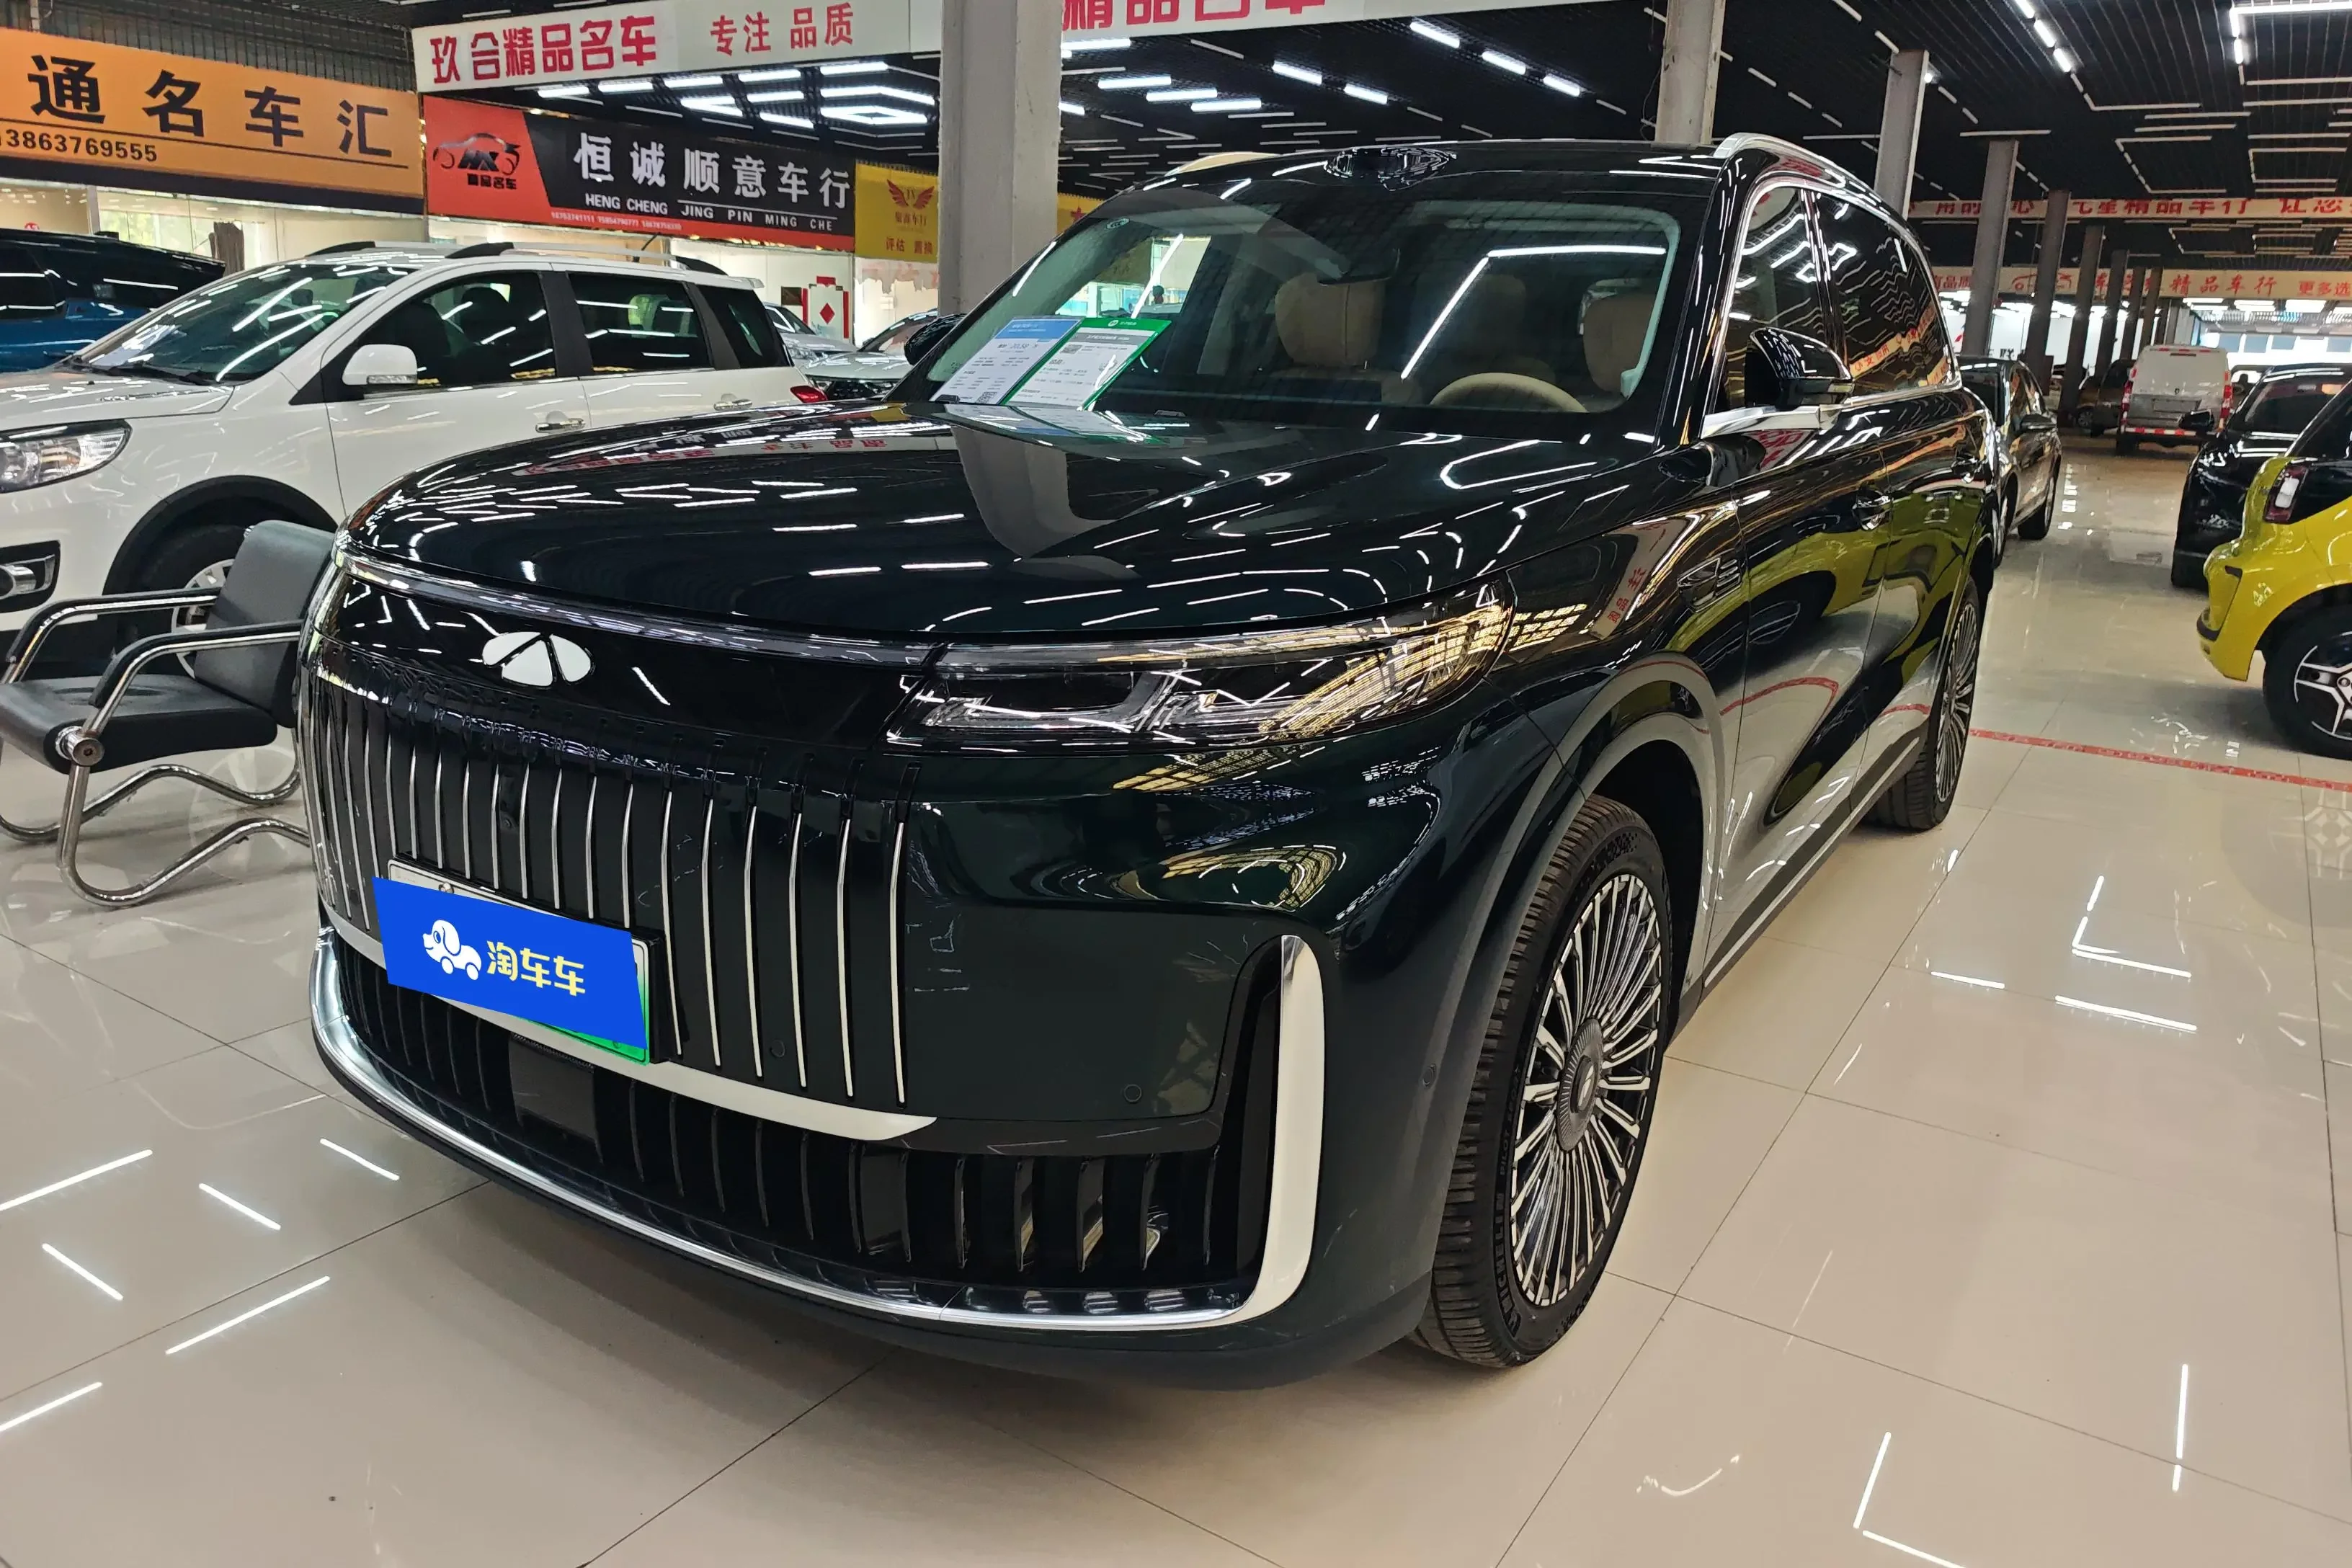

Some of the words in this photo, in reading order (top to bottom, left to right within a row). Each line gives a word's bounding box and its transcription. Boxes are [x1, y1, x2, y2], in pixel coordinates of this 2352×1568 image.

[430, 15, 656, 84] 玖合精品名车
[710, 11, 771, 56] 专注
[790, 2, 853, 49] 品质
[28, 55, 393, 158] 通名车汇
[574, 133, 850, 209] 恒诚顺意车行
[585, 192, 620, 210] HENG
[626, 198, 668, 215] CHENG
[681, 205, 714, 219] JING
[728, 211, 752, 223] PIN
[765, 215, 798, 228] MING
[810, 219, 832, 231] CHE
